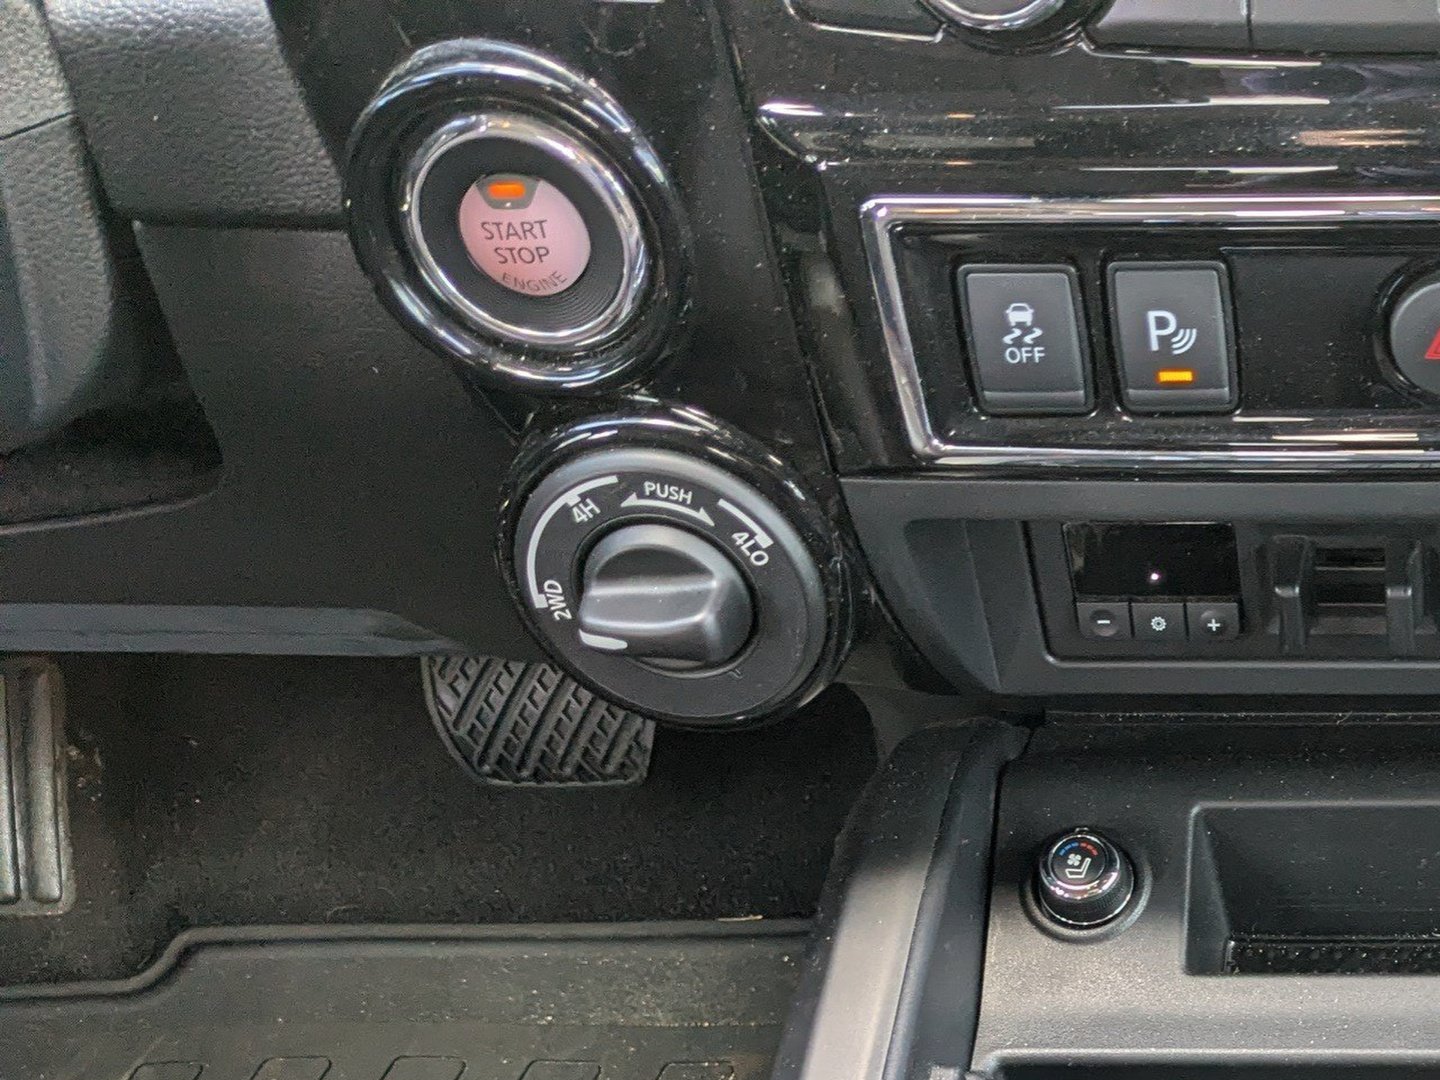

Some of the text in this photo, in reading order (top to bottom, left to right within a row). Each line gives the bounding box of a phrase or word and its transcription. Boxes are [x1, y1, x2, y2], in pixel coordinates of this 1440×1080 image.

[480, 219, 549, 241] START
[493, 245, 550, 265] STOP
[502, 270, 567, 293] ENGINE
[1004, 347, 1046, 364] OFF
[643, 481, 693, 504] PUSH
[571, 500, 601, 524] 4H
[731, 531, 769, 567] 4LO
[543, 579, 572, 622] 2WD
